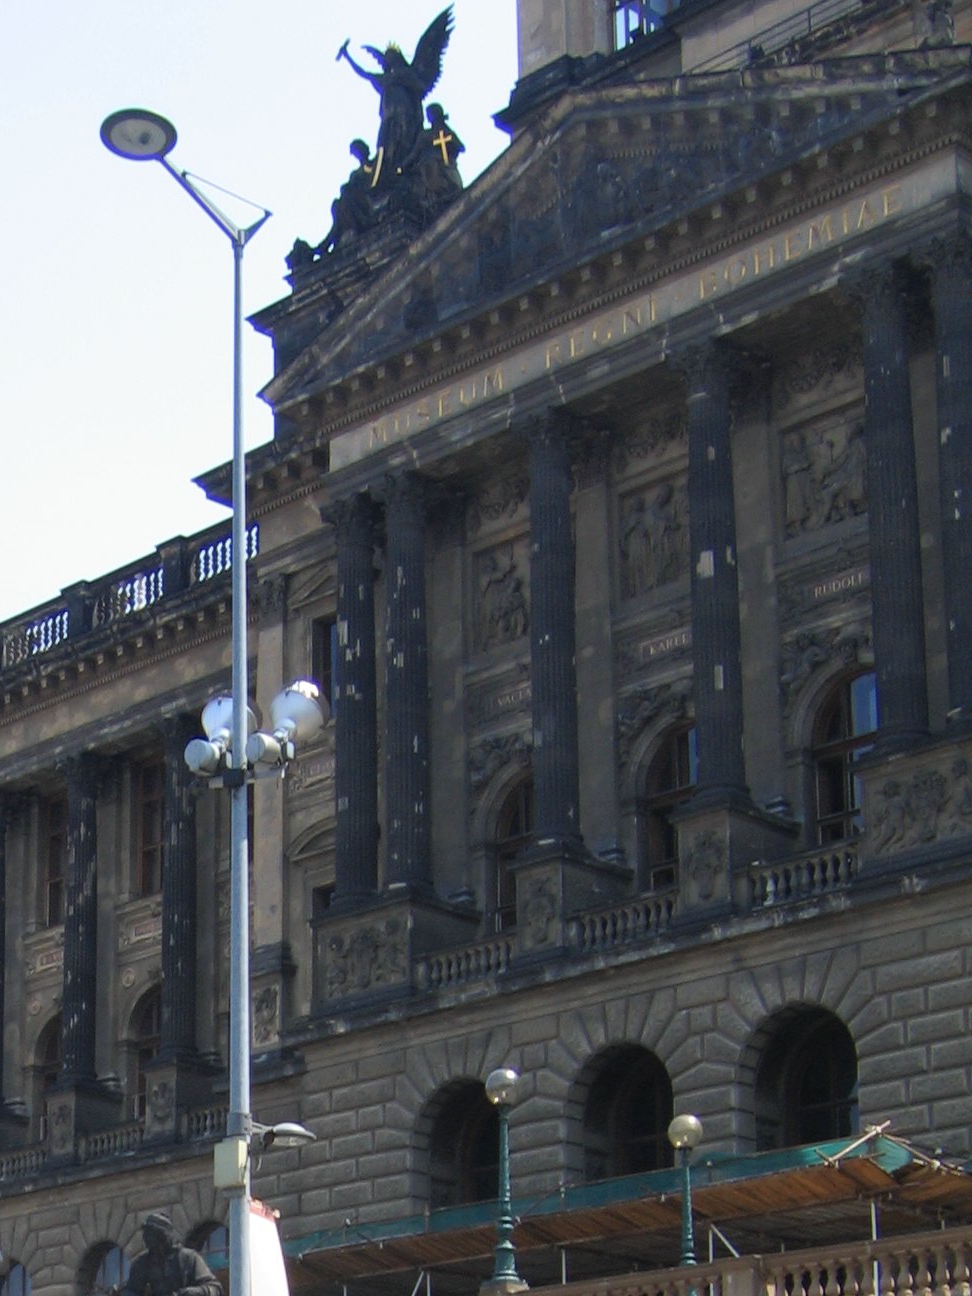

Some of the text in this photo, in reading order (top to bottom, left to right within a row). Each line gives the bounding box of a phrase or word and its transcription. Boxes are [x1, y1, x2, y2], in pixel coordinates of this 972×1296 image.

[368, 184, 902, 448] MUSEUM REGNI BOHEMIAE
[497, 688, 531, 706] VACLA
